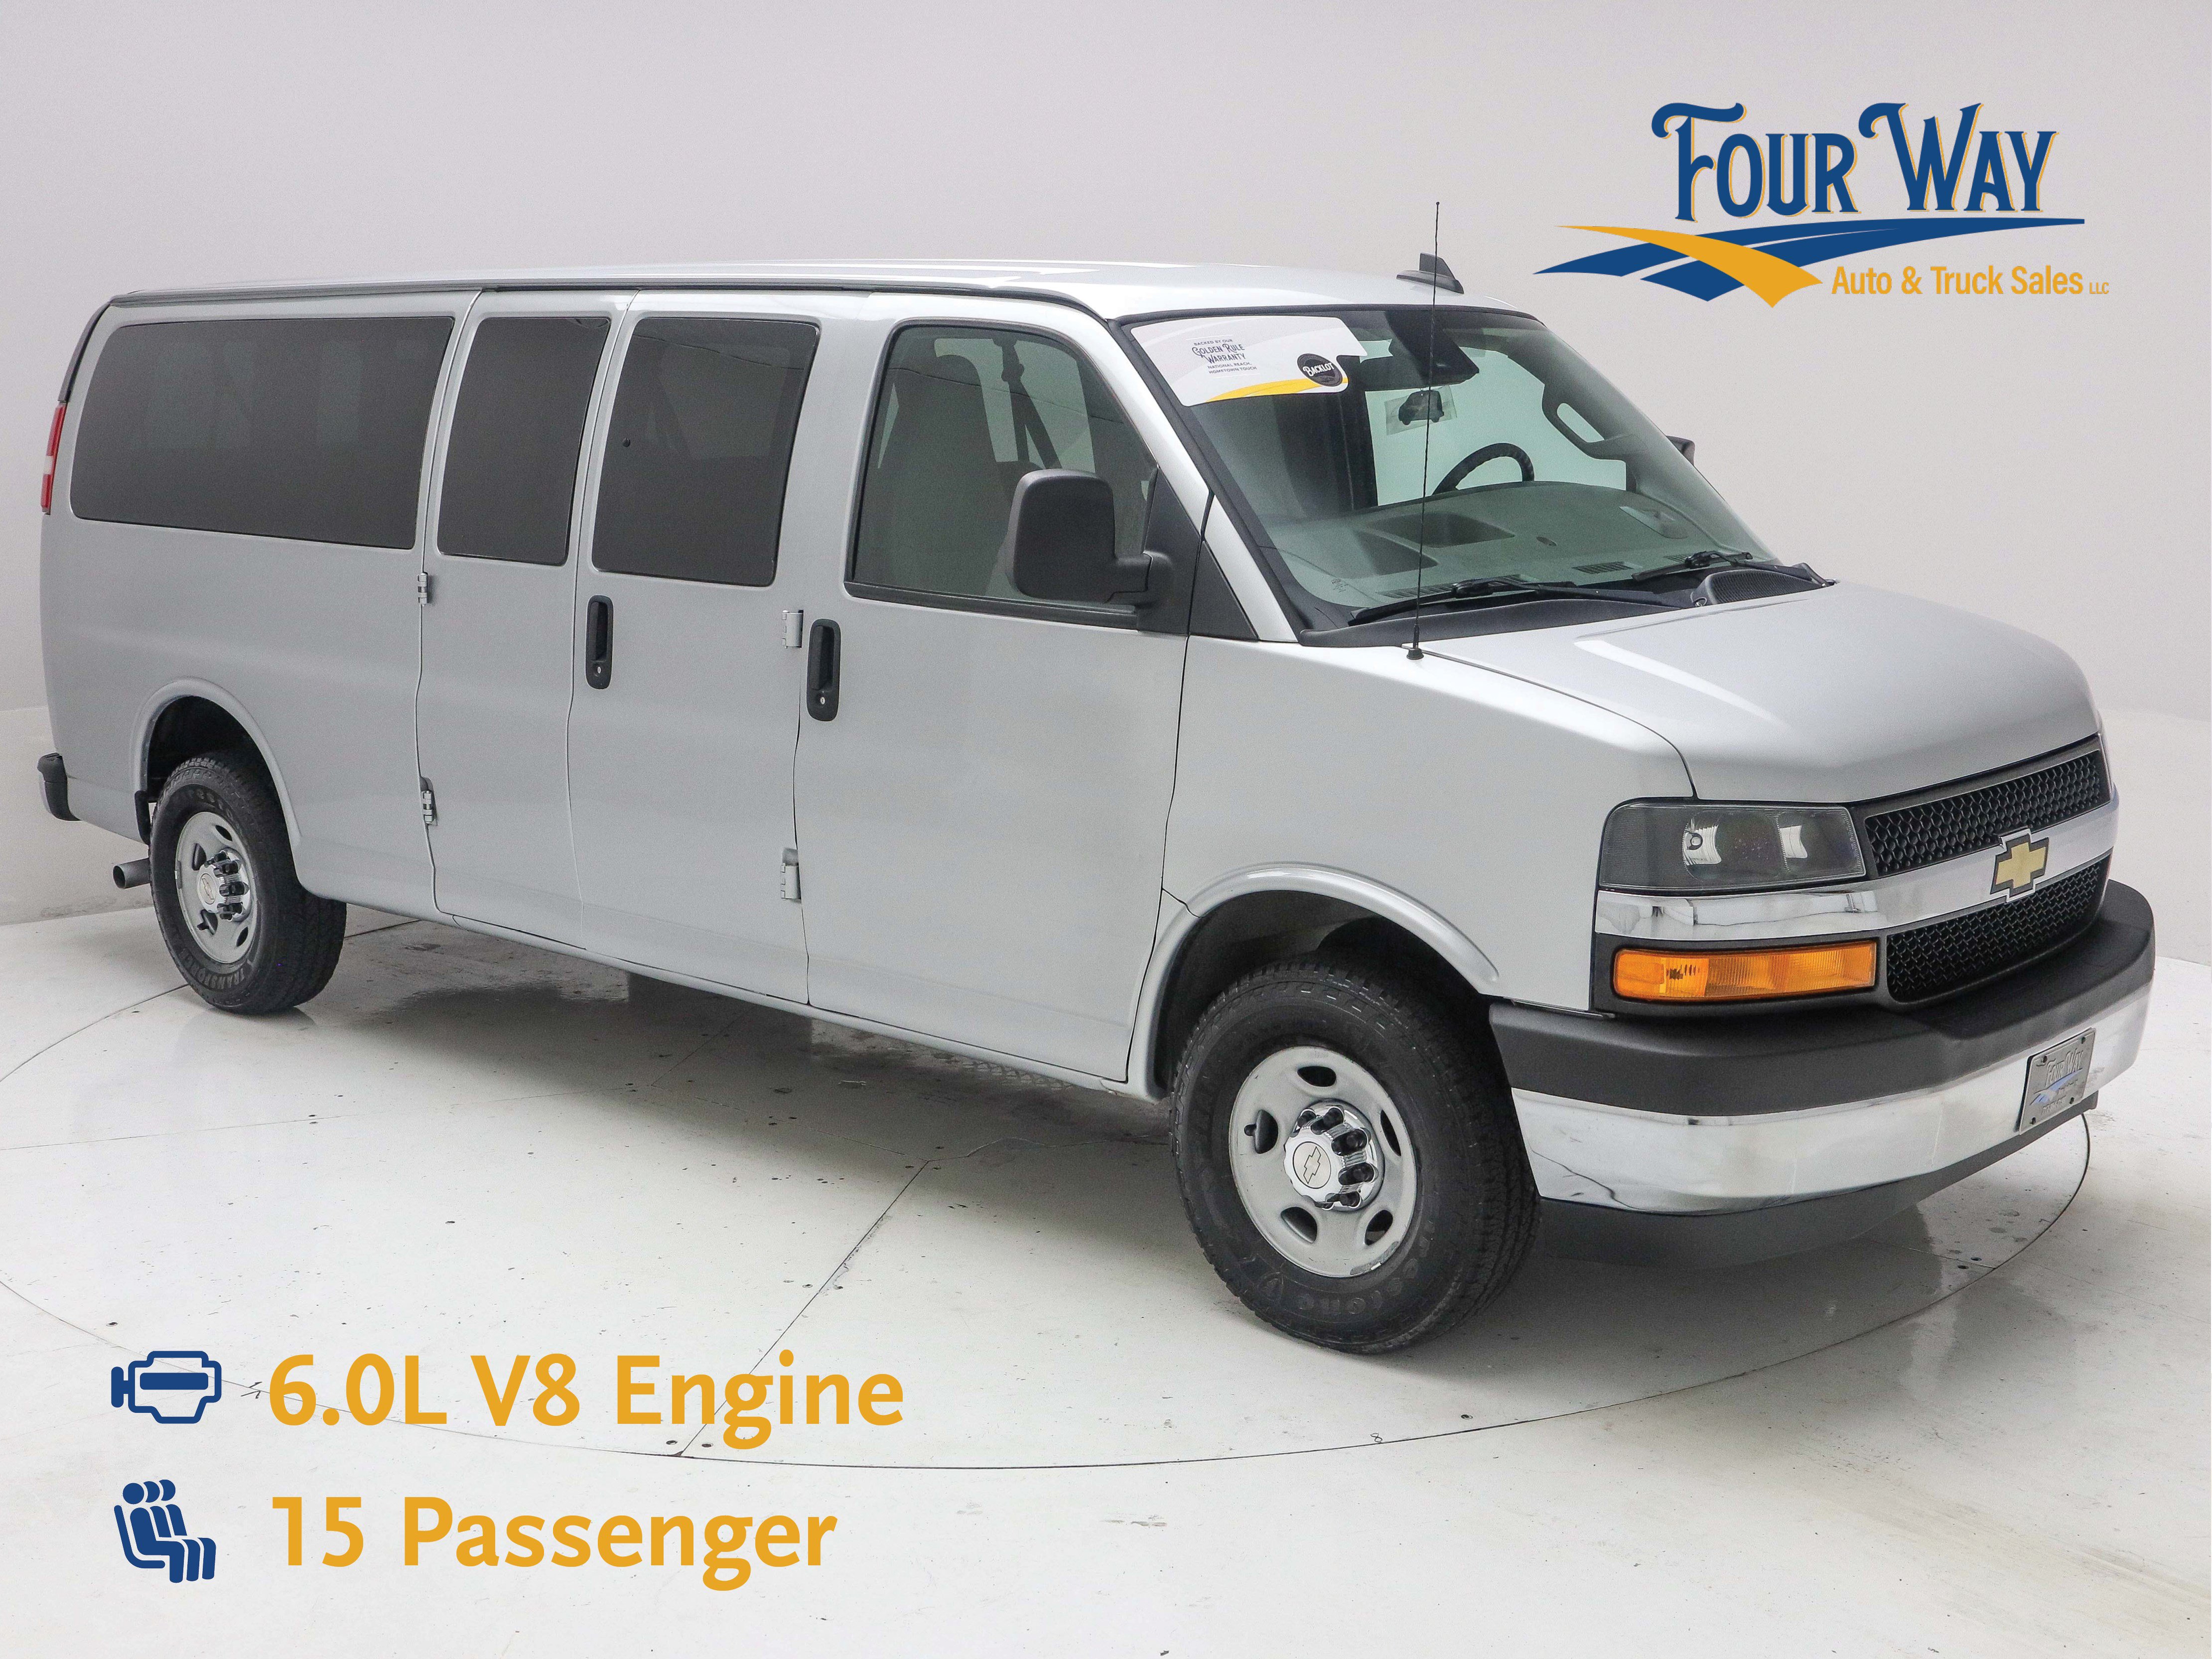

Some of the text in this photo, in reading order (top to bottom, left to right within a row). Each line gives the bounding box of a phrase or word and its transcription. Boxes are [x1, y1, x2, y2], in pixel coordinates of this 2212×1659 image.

[1192, 343, 1245, 357] GOLDEN RULE
[1201, 353, 1246, 364] WARRANTY
[1302, 362, 1335, 377] BACKLOT
